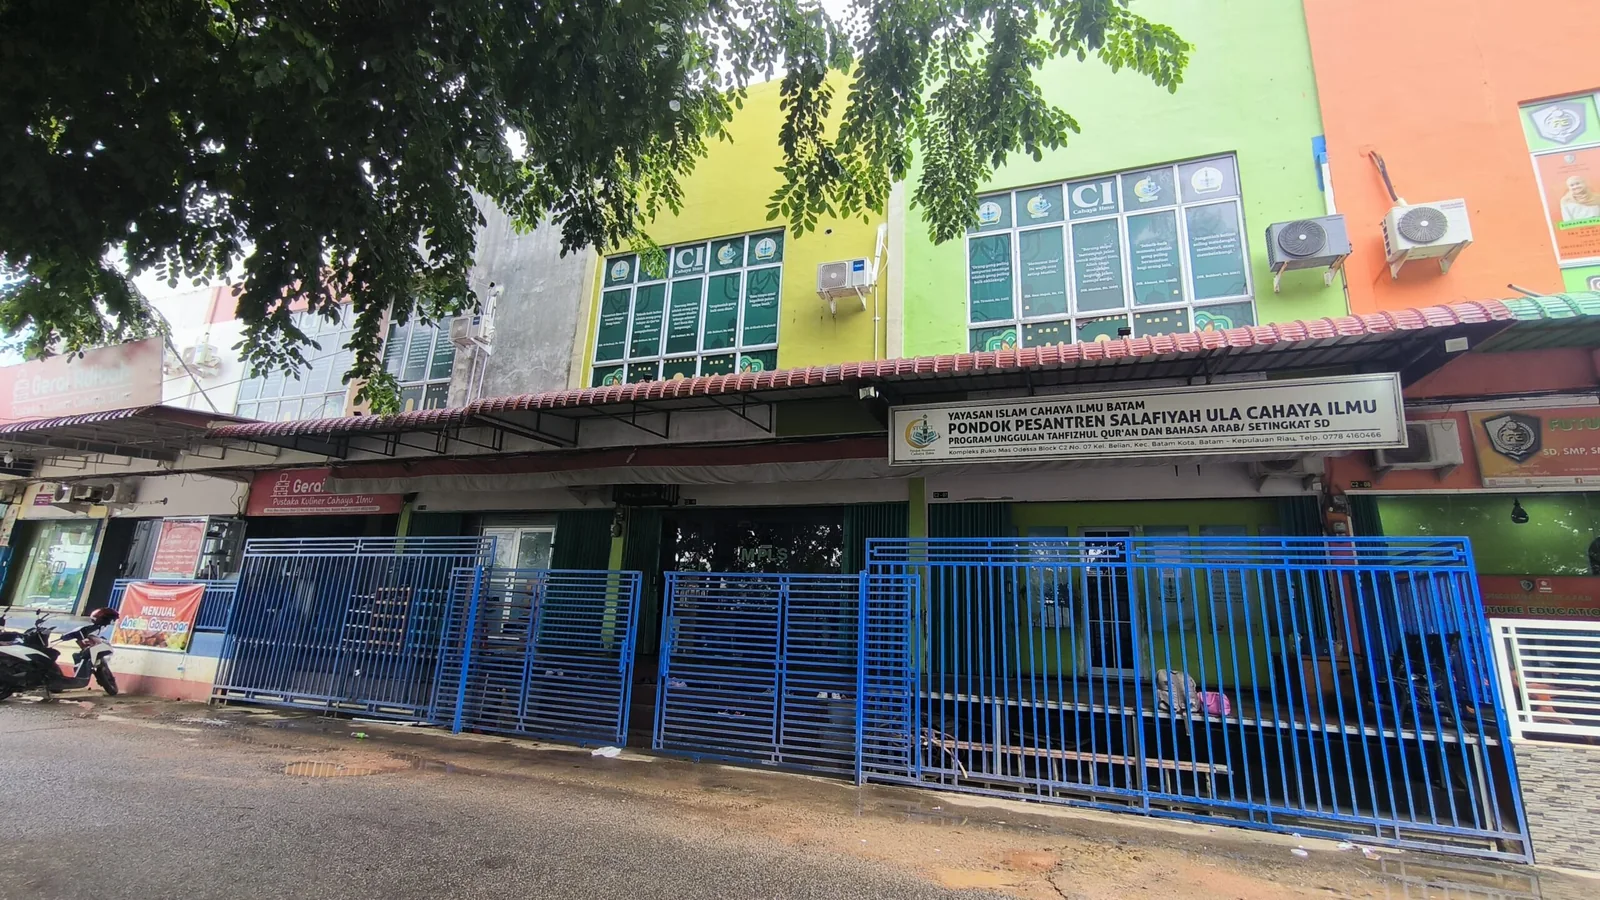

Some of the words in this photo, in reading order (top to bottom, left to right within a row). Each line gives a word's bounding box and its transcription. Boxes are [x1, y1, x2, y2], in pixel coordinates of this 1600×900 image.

[1072, 181, 1114, 208] CI
[1072, 207, 1097, 215] Cahaya
[675, 247, 705, 269] CI
[948, 410, 993, 421] YAYASAN
[996, 407, 1028, 418] ISLAM
[1030, 405, 1073, 416] CAHAYA
[1076, 403, 1104, 413] ILMU
[1107, 401, 1145, 411] BATAM
[948, 419, 1011, 435] PONDOK
[1015, 415, 1105, 431] PESANTREN
[1110, 409, 1201, 427] SALAFIYAH
[1206, 407, 1242, 422] ULA
[1246, 403, 1323, 420] CAHAYA
[1328, 399, 1377, 415] ILMU
[948, 435, 992, 445] PROGRAM
[994, 433, 1045, 443] UNGGULAN
[1047, 430, 1098, 441] TAHFIZHUL
[1101, 428, 1138, 439] QUR'AN
[1141, 427, 1163, 436] DAN
[1165, 425, 1208, 435] BAHASA
[1210, 423, 1245, 433] ARAB/
[1248, 420, 1311, 431] SETINGKAT
[1314, 418, 1330, 428] SD
[1232, 436, 1274, 444] Kepulauan
[1300, 434, 1320, 442] Telp.
[1543, 448, 1560, 456] SD,
[1563, 447, 1588, 456] SMP,
[293, 478, 326, 494] Gerai
[273, 497, 299, 506] Pustaka
[300, 496, 326, 505] Kuliner
[327, 496, 353, 506] Cahaya
[356, 496, 374, 504] Ilmu
[141, 605, 177, 617] MENJUAL
